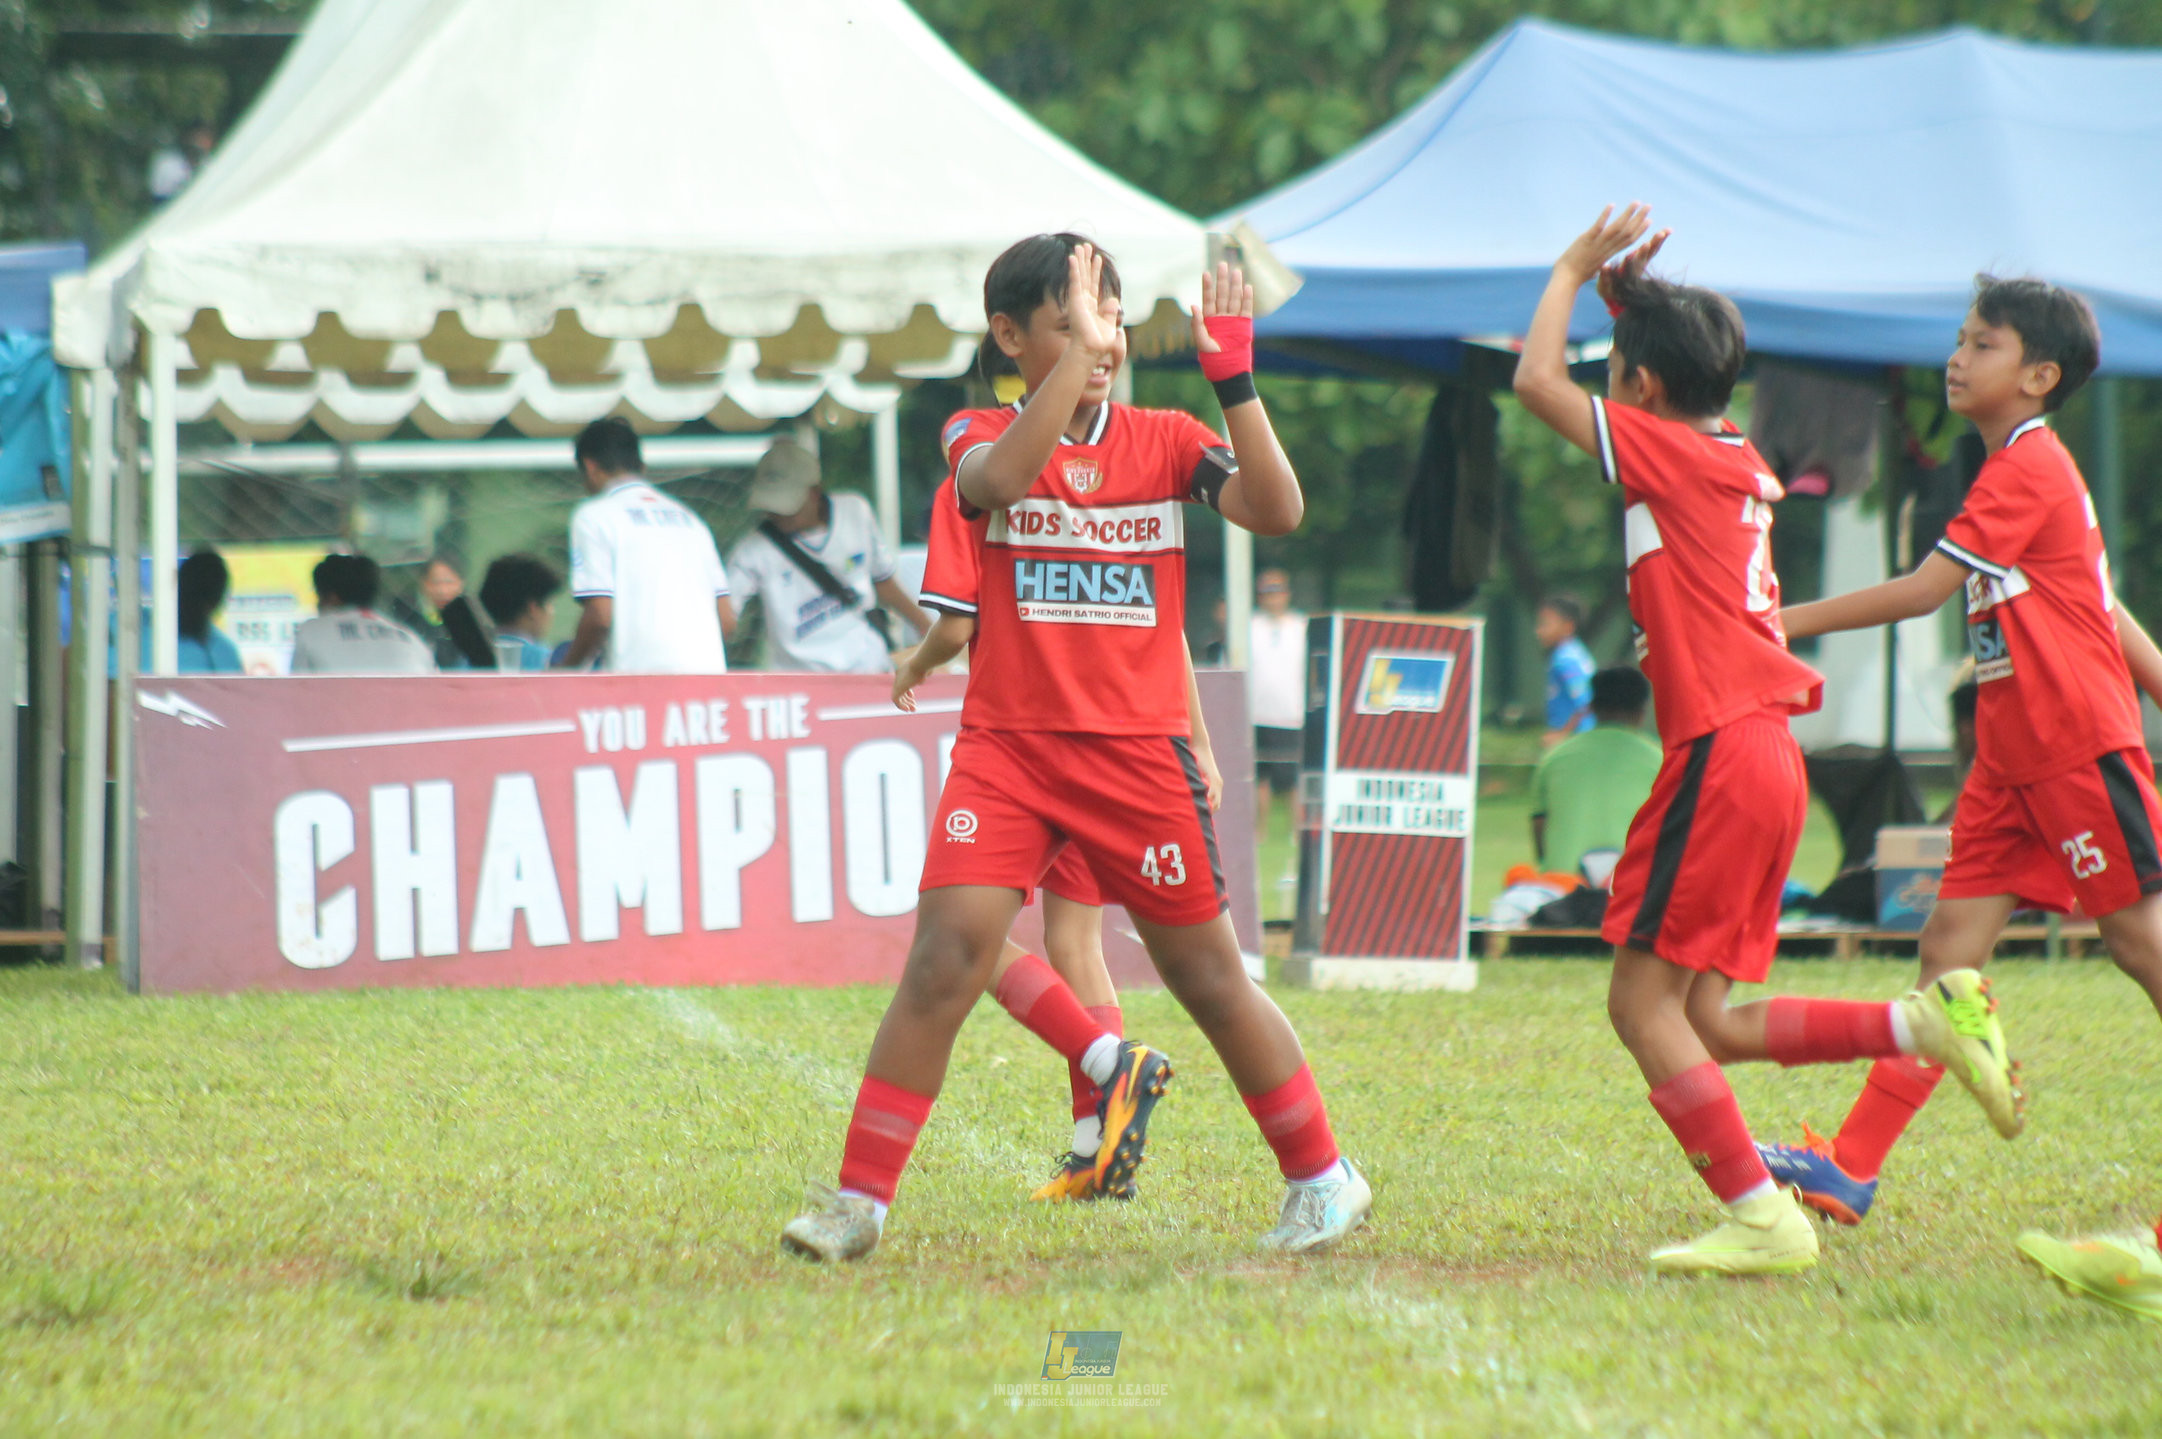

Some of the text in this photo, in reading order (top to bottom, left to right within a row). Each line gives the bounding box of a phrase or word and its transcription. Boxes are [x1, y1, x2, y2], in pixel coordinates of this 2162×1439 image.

[1005, 509, 1161, 544] KIDS SOCCER
[1015, 561, 1153, 605] HENSA
[1032, 608, 1153, 621] HENDRI SATRIO OFFICIAL
[578, 693, 812, 754] YOU ARE THE
[1335, 804, 1467, 831] JUNIOR LEAGUE
[273, 731, 957, 970] CHAMPIO
[1140, 843, 1187, 886] 43
[2061, 830, 2108, 880] 25
